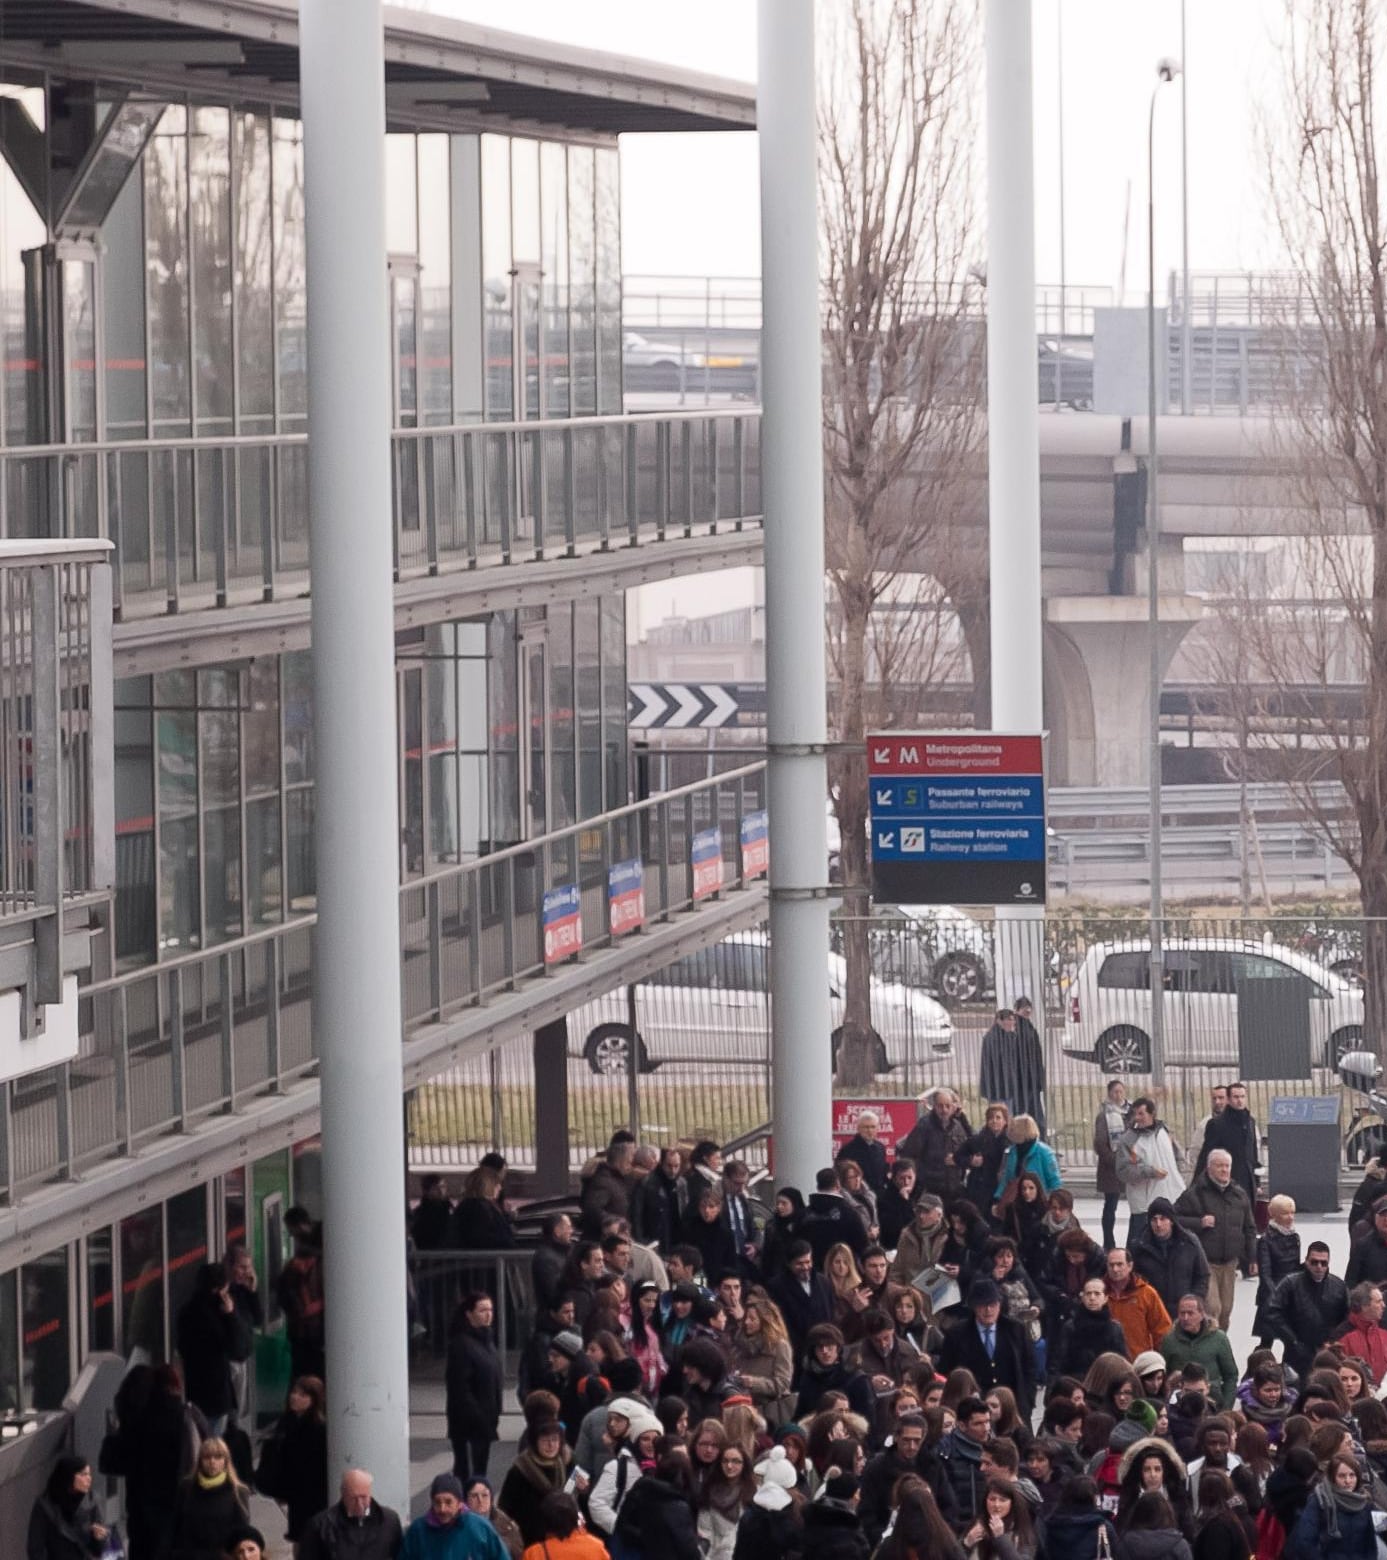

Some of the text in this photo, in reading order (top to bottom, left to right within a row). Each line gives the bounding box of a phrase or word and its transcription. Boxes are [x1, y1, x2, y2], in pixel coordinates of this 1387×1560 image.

[926, 743, 1003, 756] Metropolitana
[927, 757, 1001, 768] Underground
[928, 786, 976, 797] Passante
[929, 799, 1024, 811] Suburban railways
[930, 842, 1008, 854] Railway station
